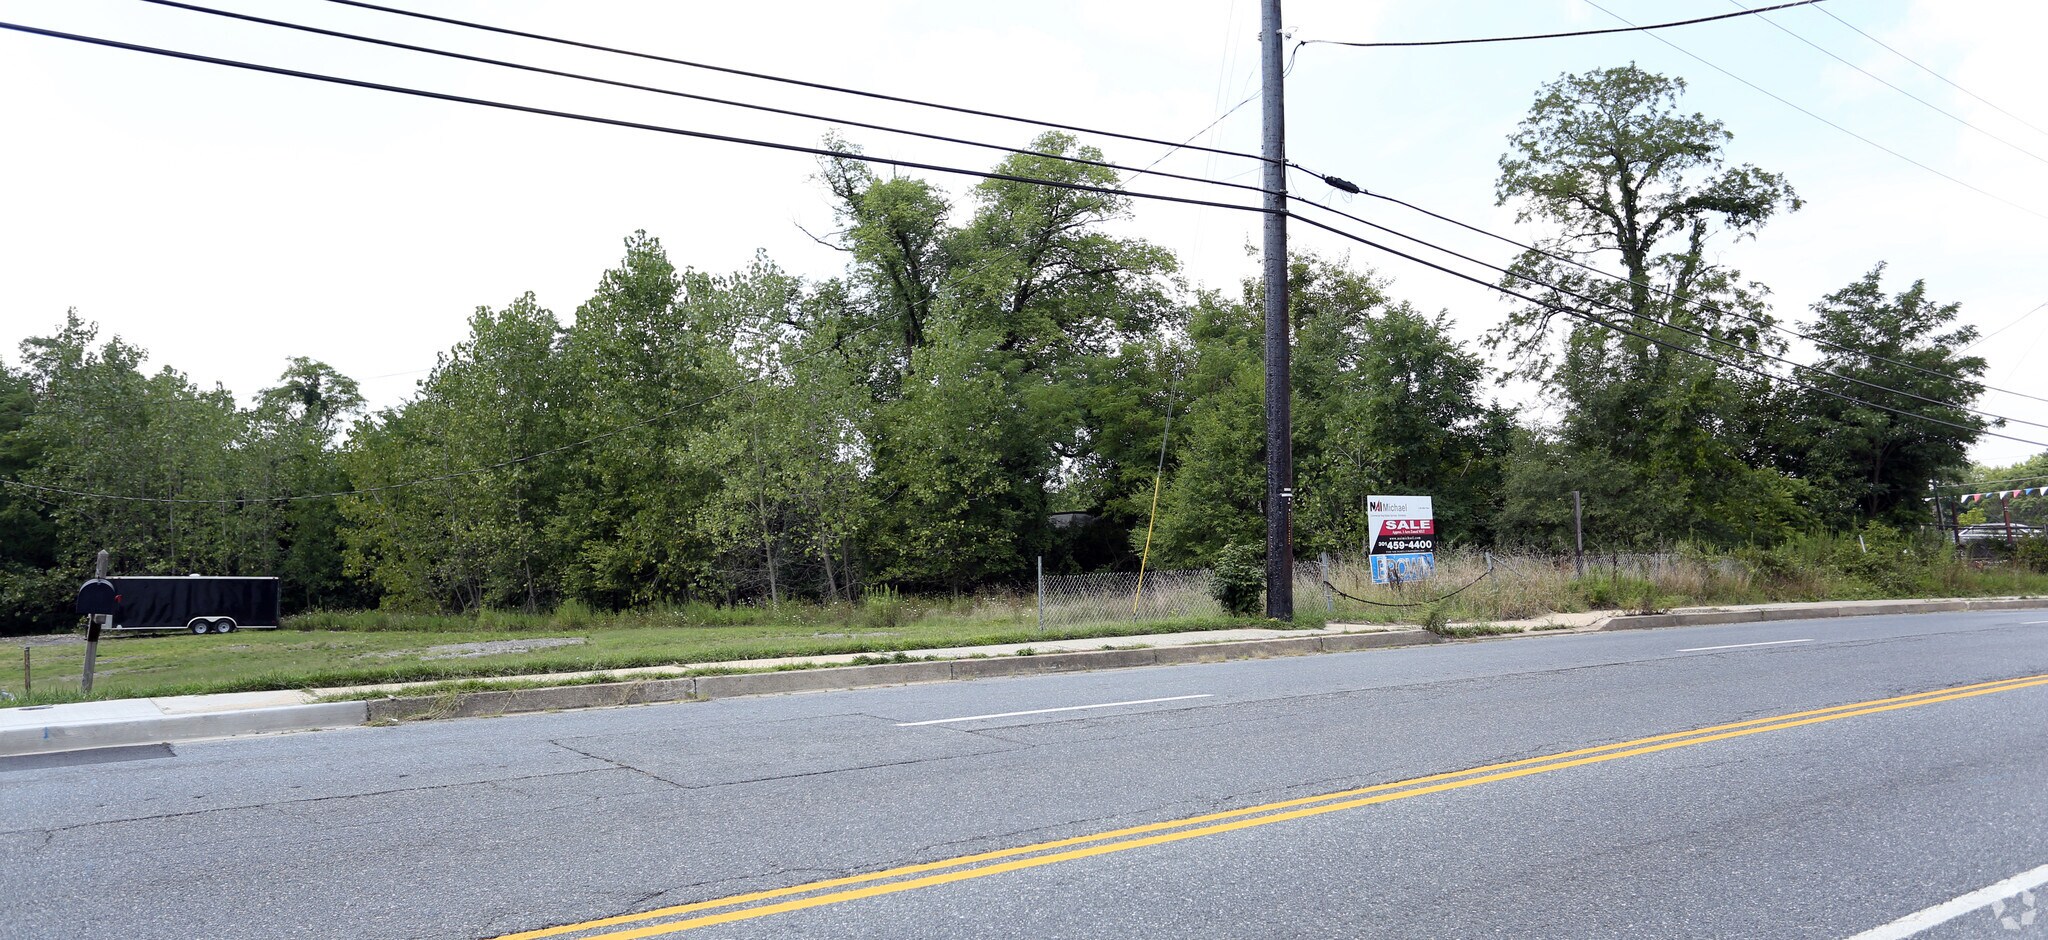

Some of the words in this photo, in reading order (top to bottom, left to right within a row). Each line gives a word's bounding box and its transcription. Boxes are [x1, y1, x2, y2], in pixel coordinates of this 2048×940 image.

[1370, 500, 1382, 512] NAI
[1383, 503, 1407, 512] Michael
[1385, 520, 1431, 530] SALE
[1387, 540, 1432, 550] 459-4400
